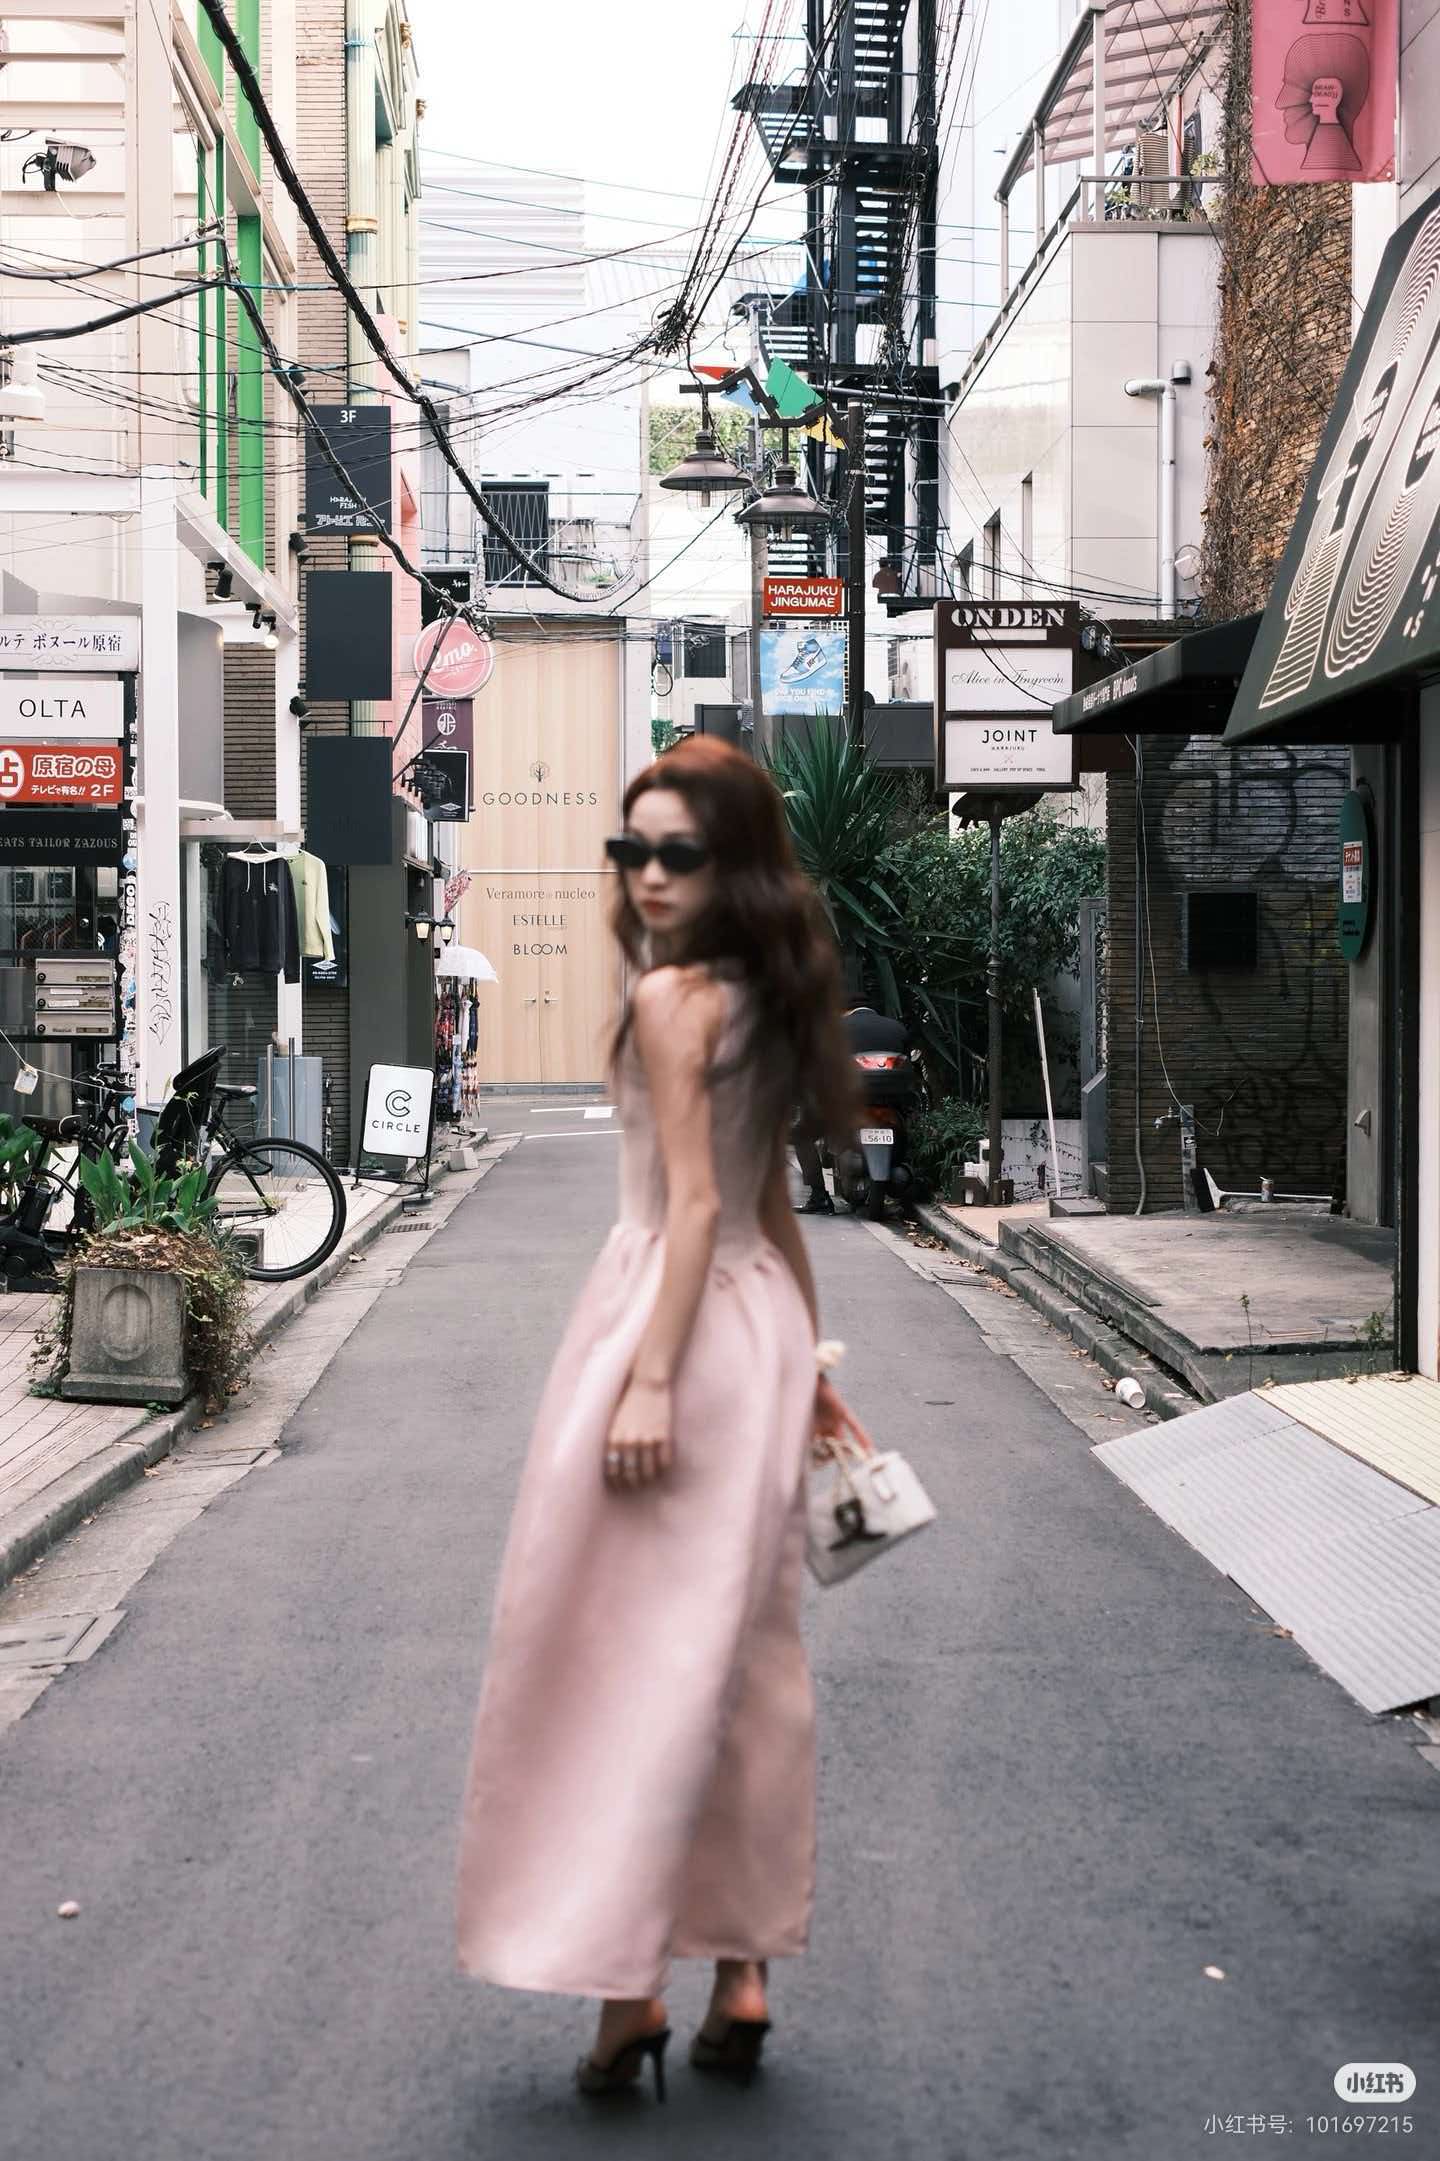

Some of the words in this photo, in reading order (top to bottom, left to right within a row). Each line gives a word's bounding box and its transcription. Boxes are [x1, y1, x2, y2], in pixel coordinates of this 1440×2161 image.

[340, 410, 357, 423] 3F
[768, 585, 838, 596] HARAJUKU
[770, 597, 835, 608] JINGUMAE
[951, 607, 1066, 628] ONDEN
[951, 669, 990, 685] Alice
[19, 698, 87, 718] OLTA
[982, 729, 1037, 743] JOINT
[0, 756, 20, 788] 占
[32, 755, 116, 778] 原宿の母
[90, 784, 115, 797] 2F
[482, 792, 598, 806] GOODNESS
[30, 838, 72, 848] TAILOR
[74, 838, 118, 849] ZAZOUS
[486, 887, 545, 900] Veramore
[555, 887, 596, 900] nucleo
[513, 914, 568, 926] ESTELLE
[513, 944, 568, 956] BLOOM
[371, 1120, 421, 1133] CIRCLE
